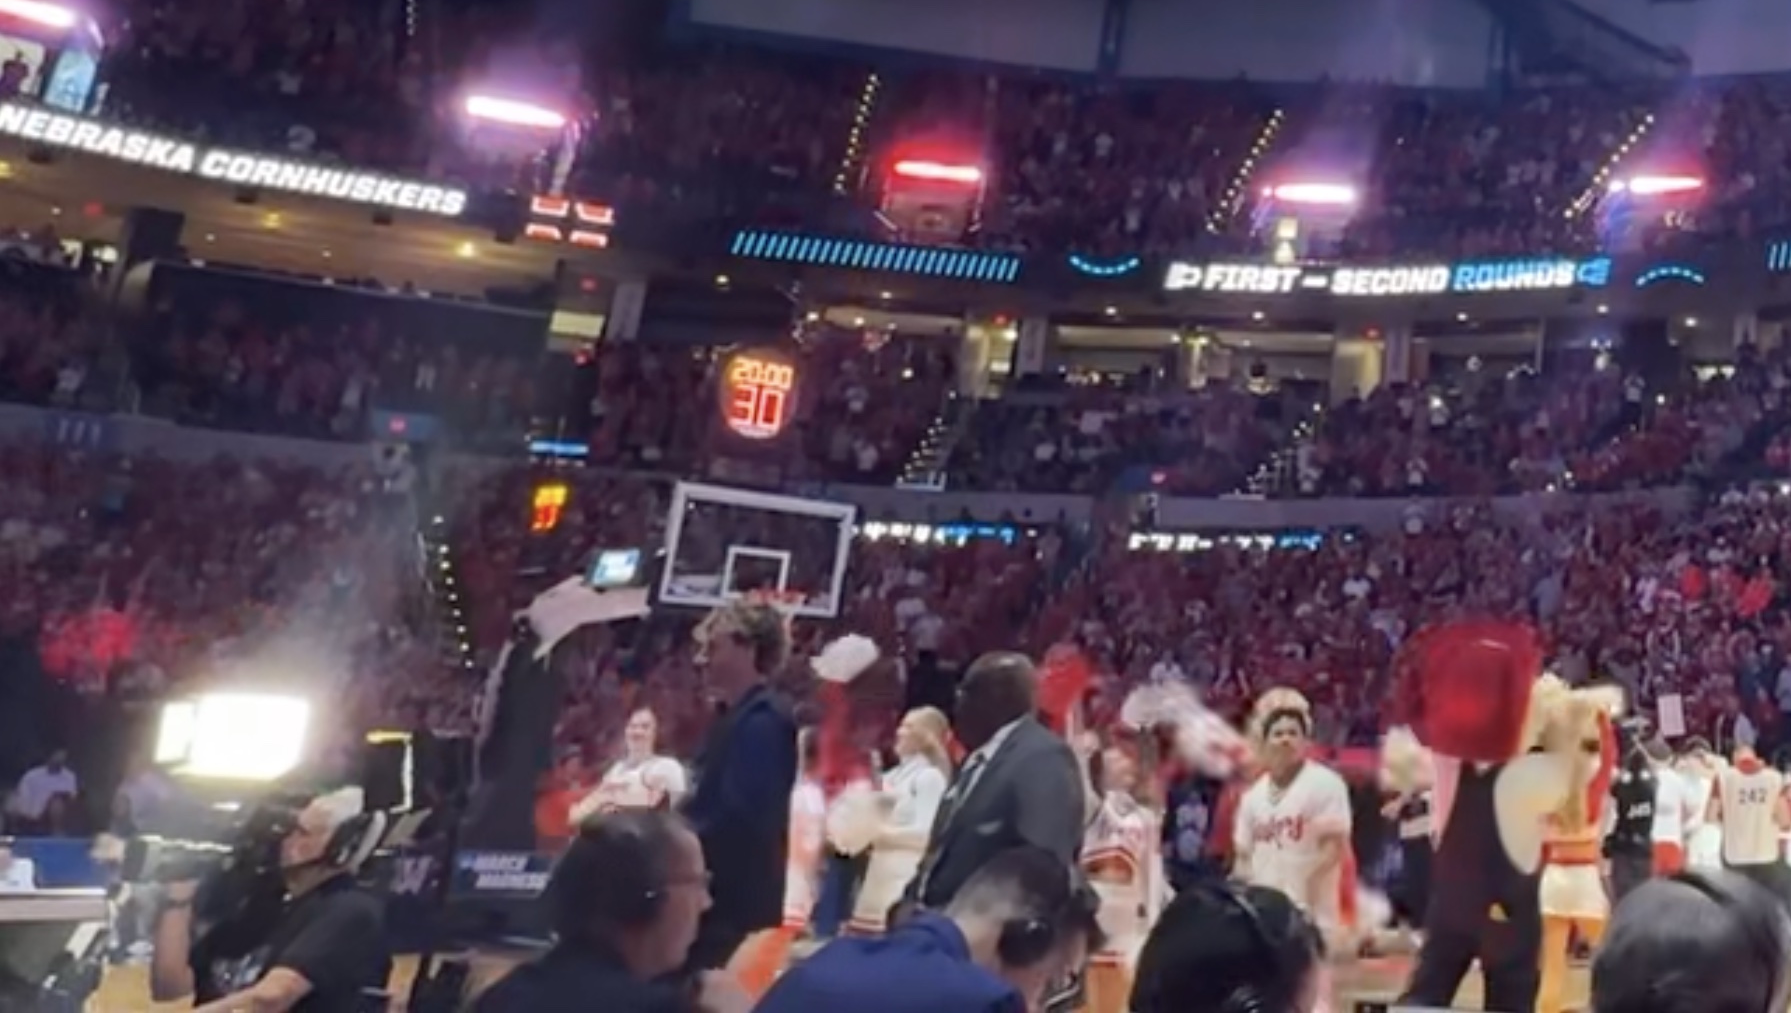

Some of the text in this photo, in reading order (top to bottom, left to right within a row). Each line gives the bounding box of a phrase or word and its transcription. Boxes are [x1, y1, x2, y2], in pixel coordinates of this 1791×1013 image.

[0, 103, 468, 217] NEBRASKA CORNHUSKERS
[1203, 264, 1302, 293] FIRST
[1330, 266, 1450, 295] SECOND
[1453, 261, 1577, 291] ROUNDS
[731, 355, 795, 392] 20:00
